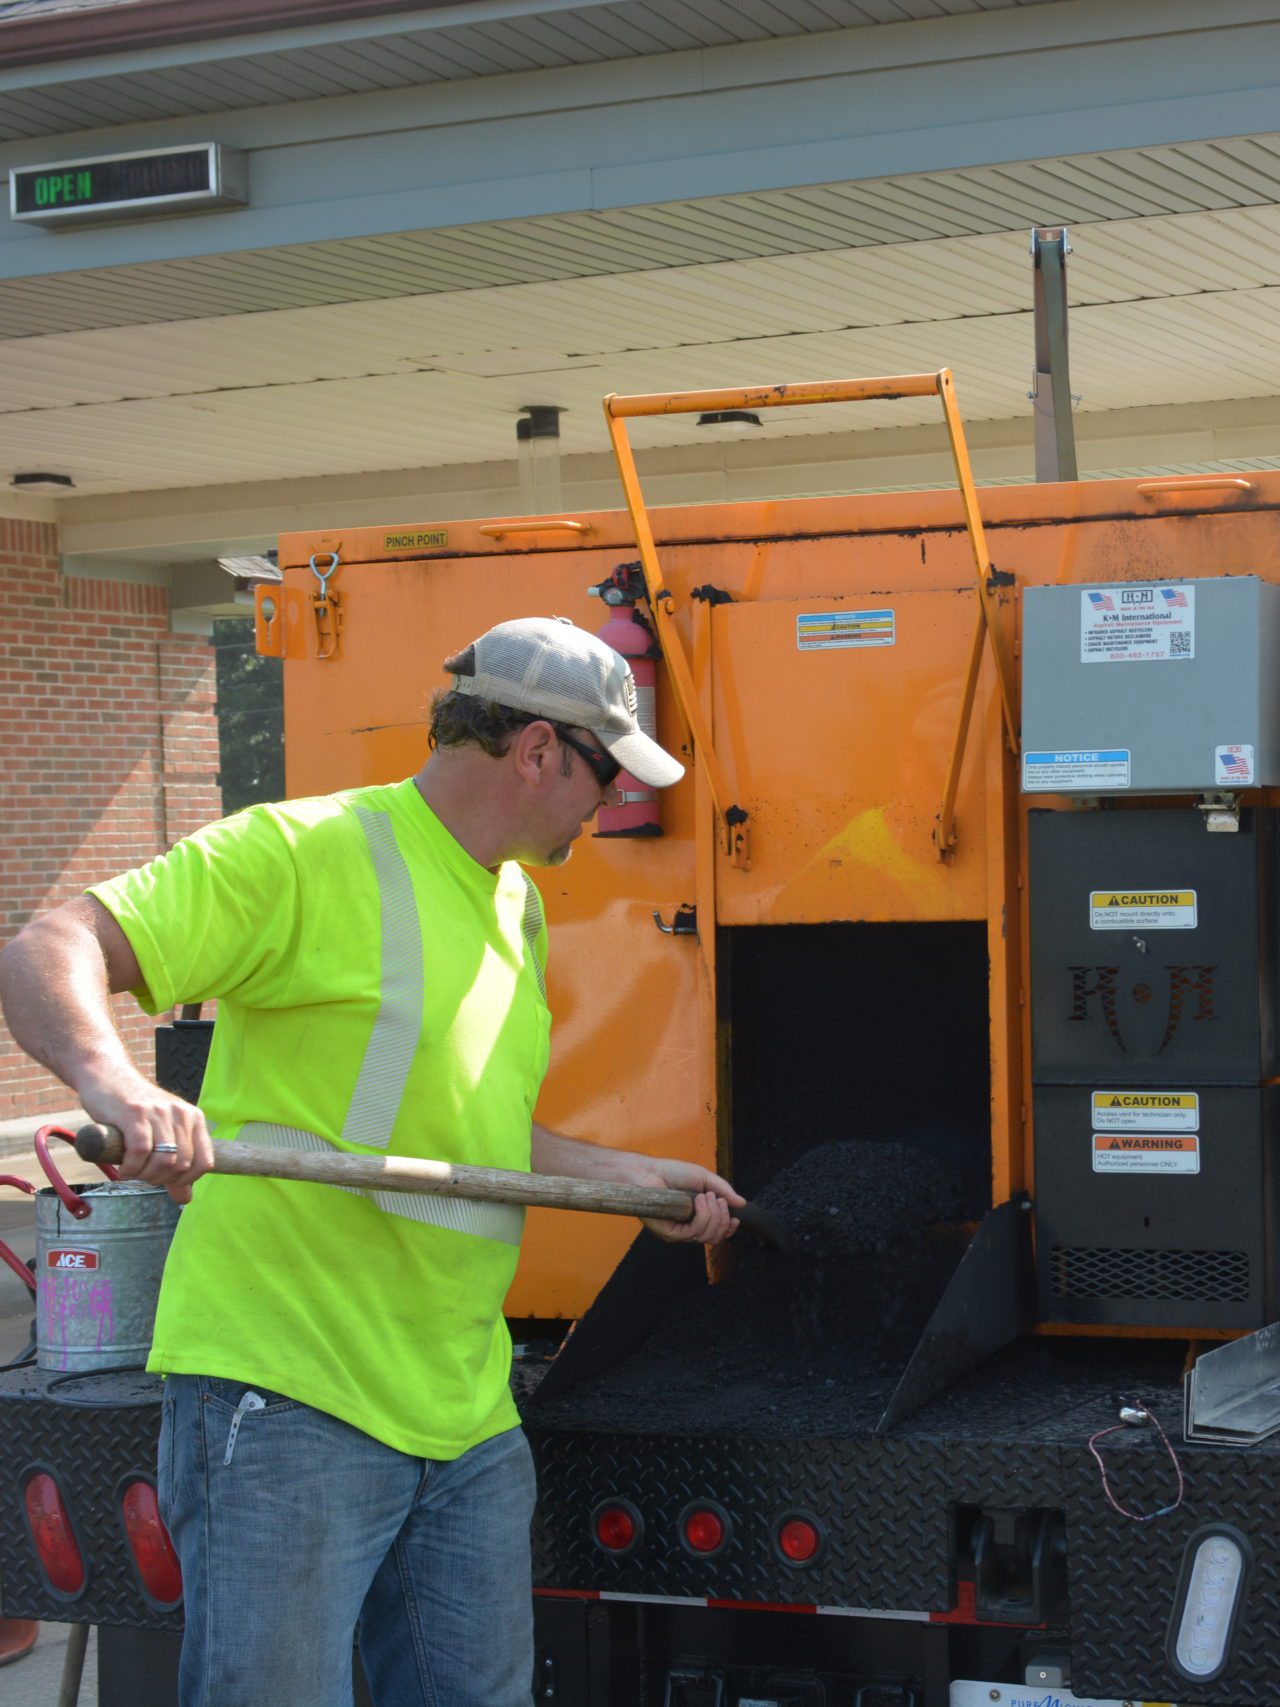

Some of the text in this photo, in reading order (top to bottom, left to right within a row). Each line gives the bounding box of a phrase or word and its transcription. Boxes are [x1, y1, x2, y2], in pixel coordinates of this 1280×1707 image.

[35, 171, 92, 205] OPEN
[386, 533, 444, 548] PINCH POINT
[1122, 612, 1171, 620] International
[1055, 753, 1099, 762] NOTICE
[1121, 895, 1178, 904] CAUTION
[1123, 1097, 1180, 1106] CAUTION
[1122, 1139, 1182, 1148] WARNING
[56, 1253, 85, 1268] ACE
